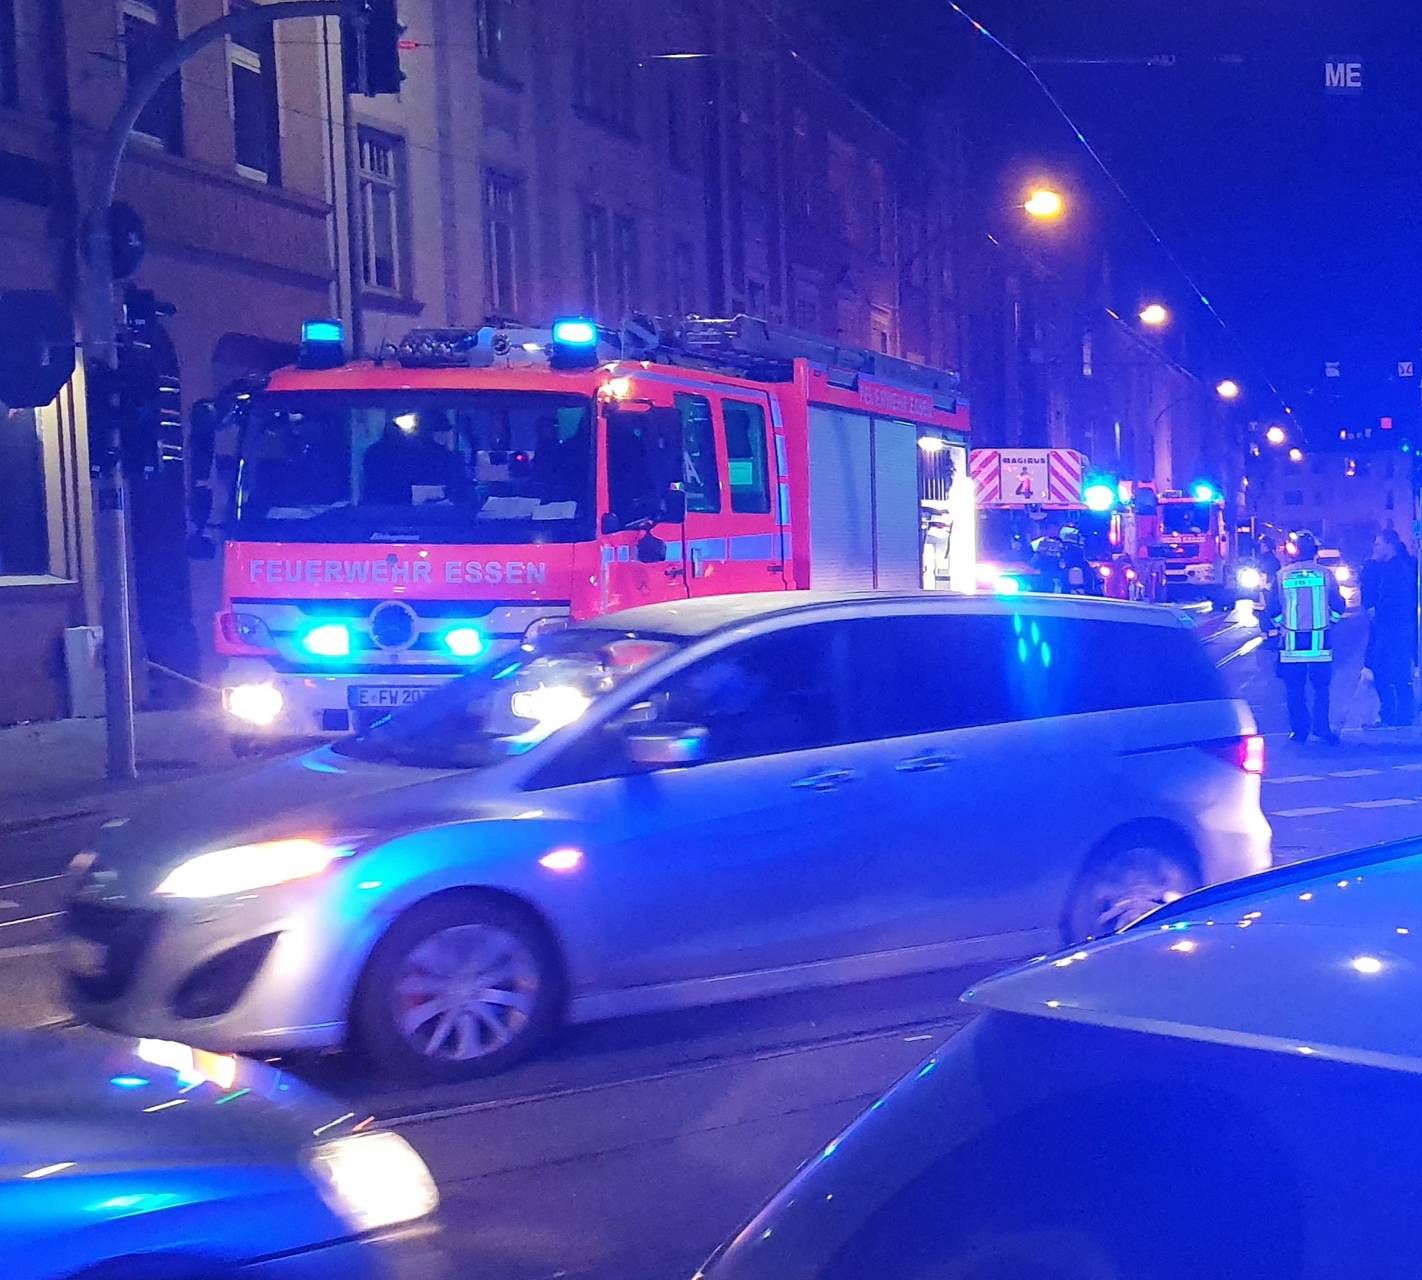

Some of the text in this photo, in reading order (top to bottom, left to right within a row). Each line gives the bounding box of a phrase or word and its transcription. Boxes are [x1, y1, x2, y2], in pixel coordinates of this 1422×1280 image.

[1325, 63, 1361, 87] ME
[249, 559, 545, 584] FEUERWEHR ESSEN
